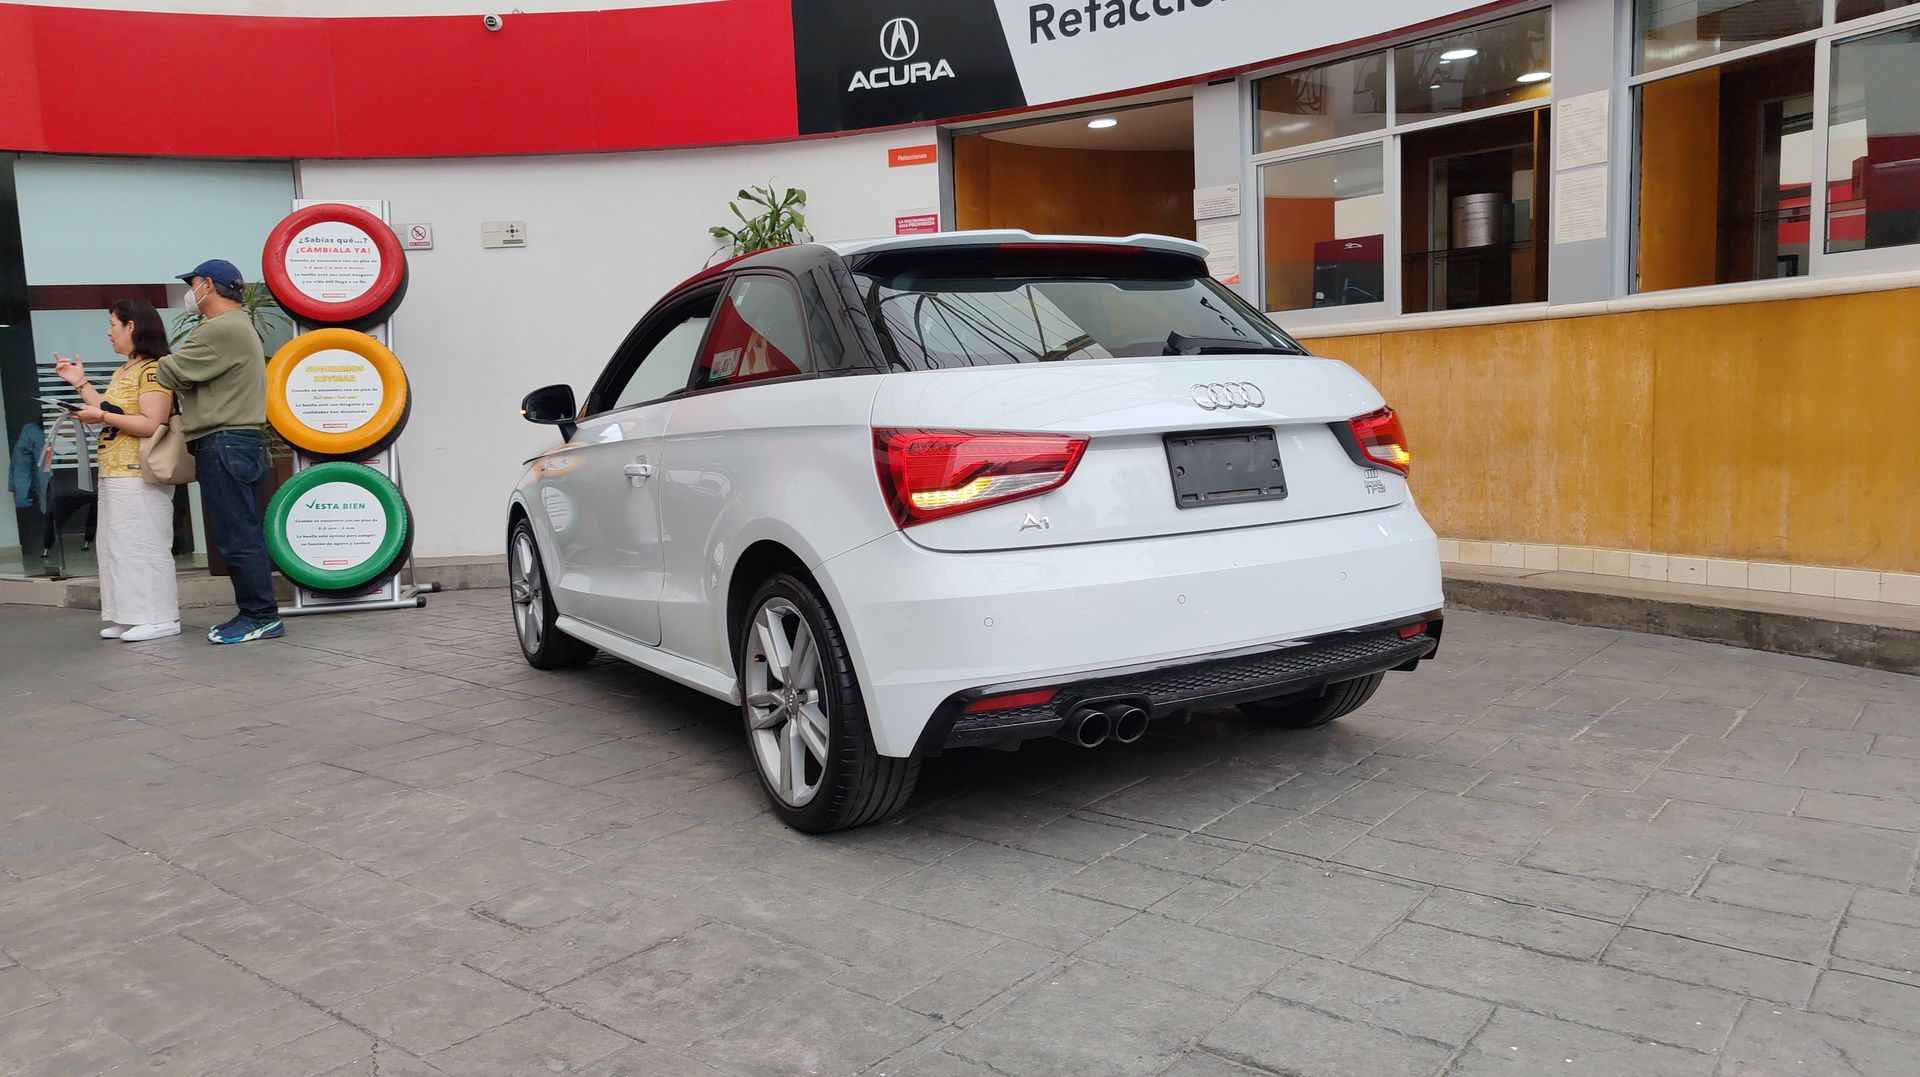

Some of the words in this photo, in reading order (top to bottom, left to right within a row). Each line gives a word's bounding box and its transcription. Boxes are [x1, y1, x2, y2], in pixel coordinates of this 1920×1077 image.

[1029, 0, 1227, 44] Refacc
[848, 59, 955, 92] ACURA
[1019, 512, 1050, 532] A1
